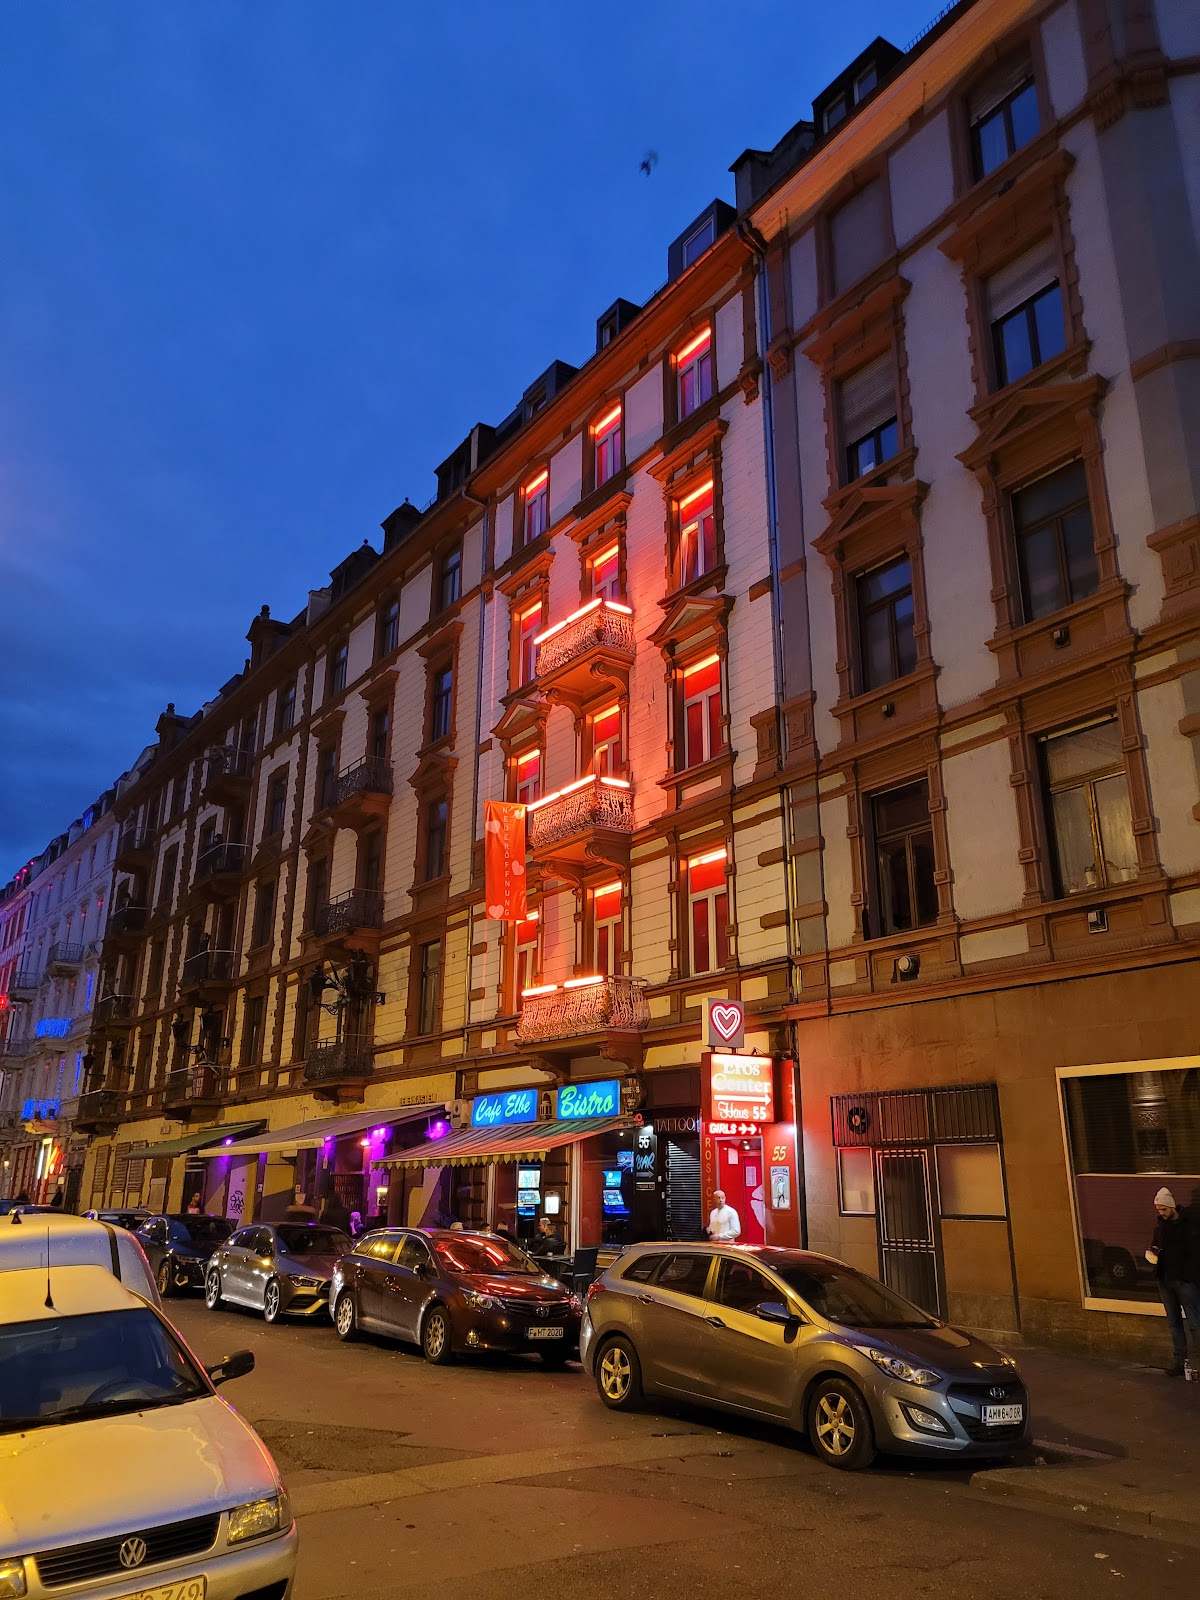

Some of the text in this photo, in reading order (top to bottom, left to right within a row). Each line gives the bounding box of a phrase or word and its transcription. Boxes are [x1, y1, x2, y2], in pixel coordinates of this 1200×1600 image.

[712, 1072, 771, 1092] Center
[475, 1093, 531, 1123] Cafe Elbe
[560, 1086, 615, 1117] Bistro
[718, 1101, 767, 1120] Haus 55
[709, 1123, 737, 1134] GIRLS
[638, 1135, 650, 1148] 55
[772, 1146, 787, 1161] 55
